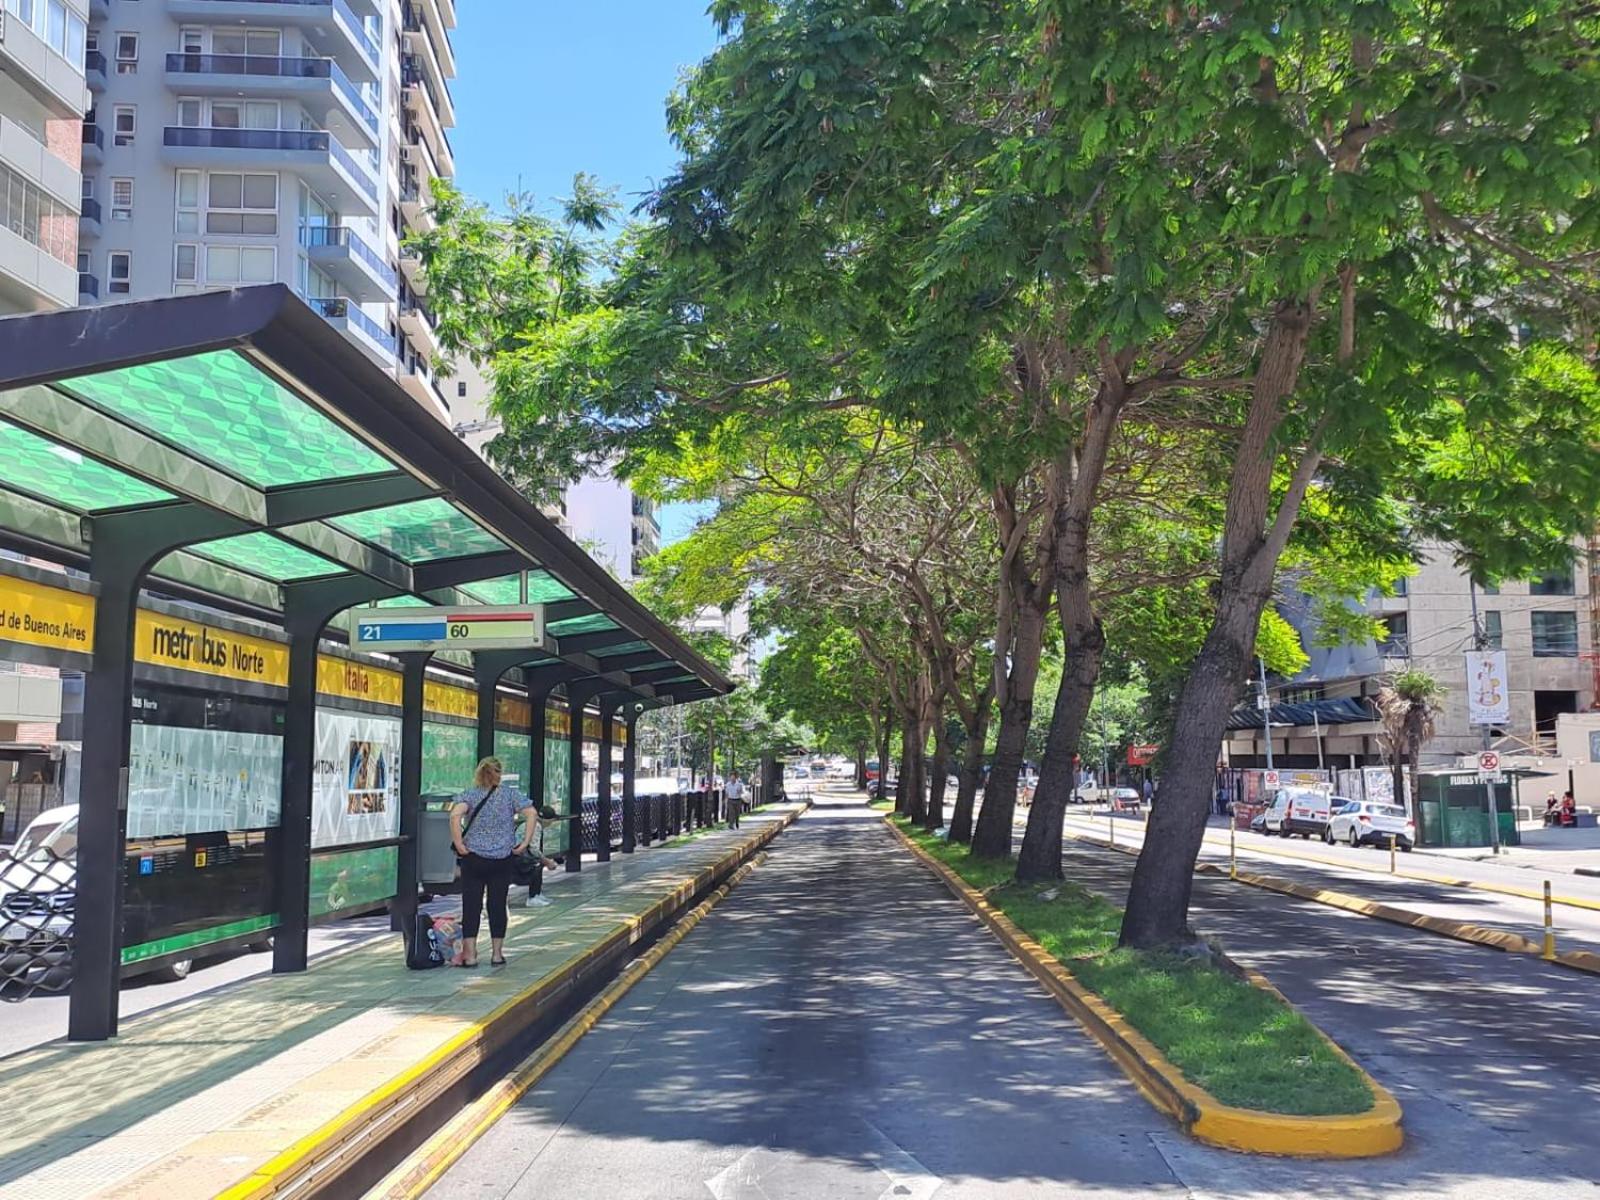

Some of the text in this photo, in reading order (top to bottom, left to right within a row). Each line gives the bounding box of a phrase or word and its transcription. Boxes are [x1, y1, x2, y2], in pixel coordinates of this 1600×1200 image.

[8, 612, 21, 630] de
[24, 614, 60, 637] Buenos
[62, 622, 87, 641] Aires
[363, 626, 382, 640] 21
[450, 624, 469, 638] 60
[232, 644, 264, 674] Norte
[344, 661, 369, 694] Italia
